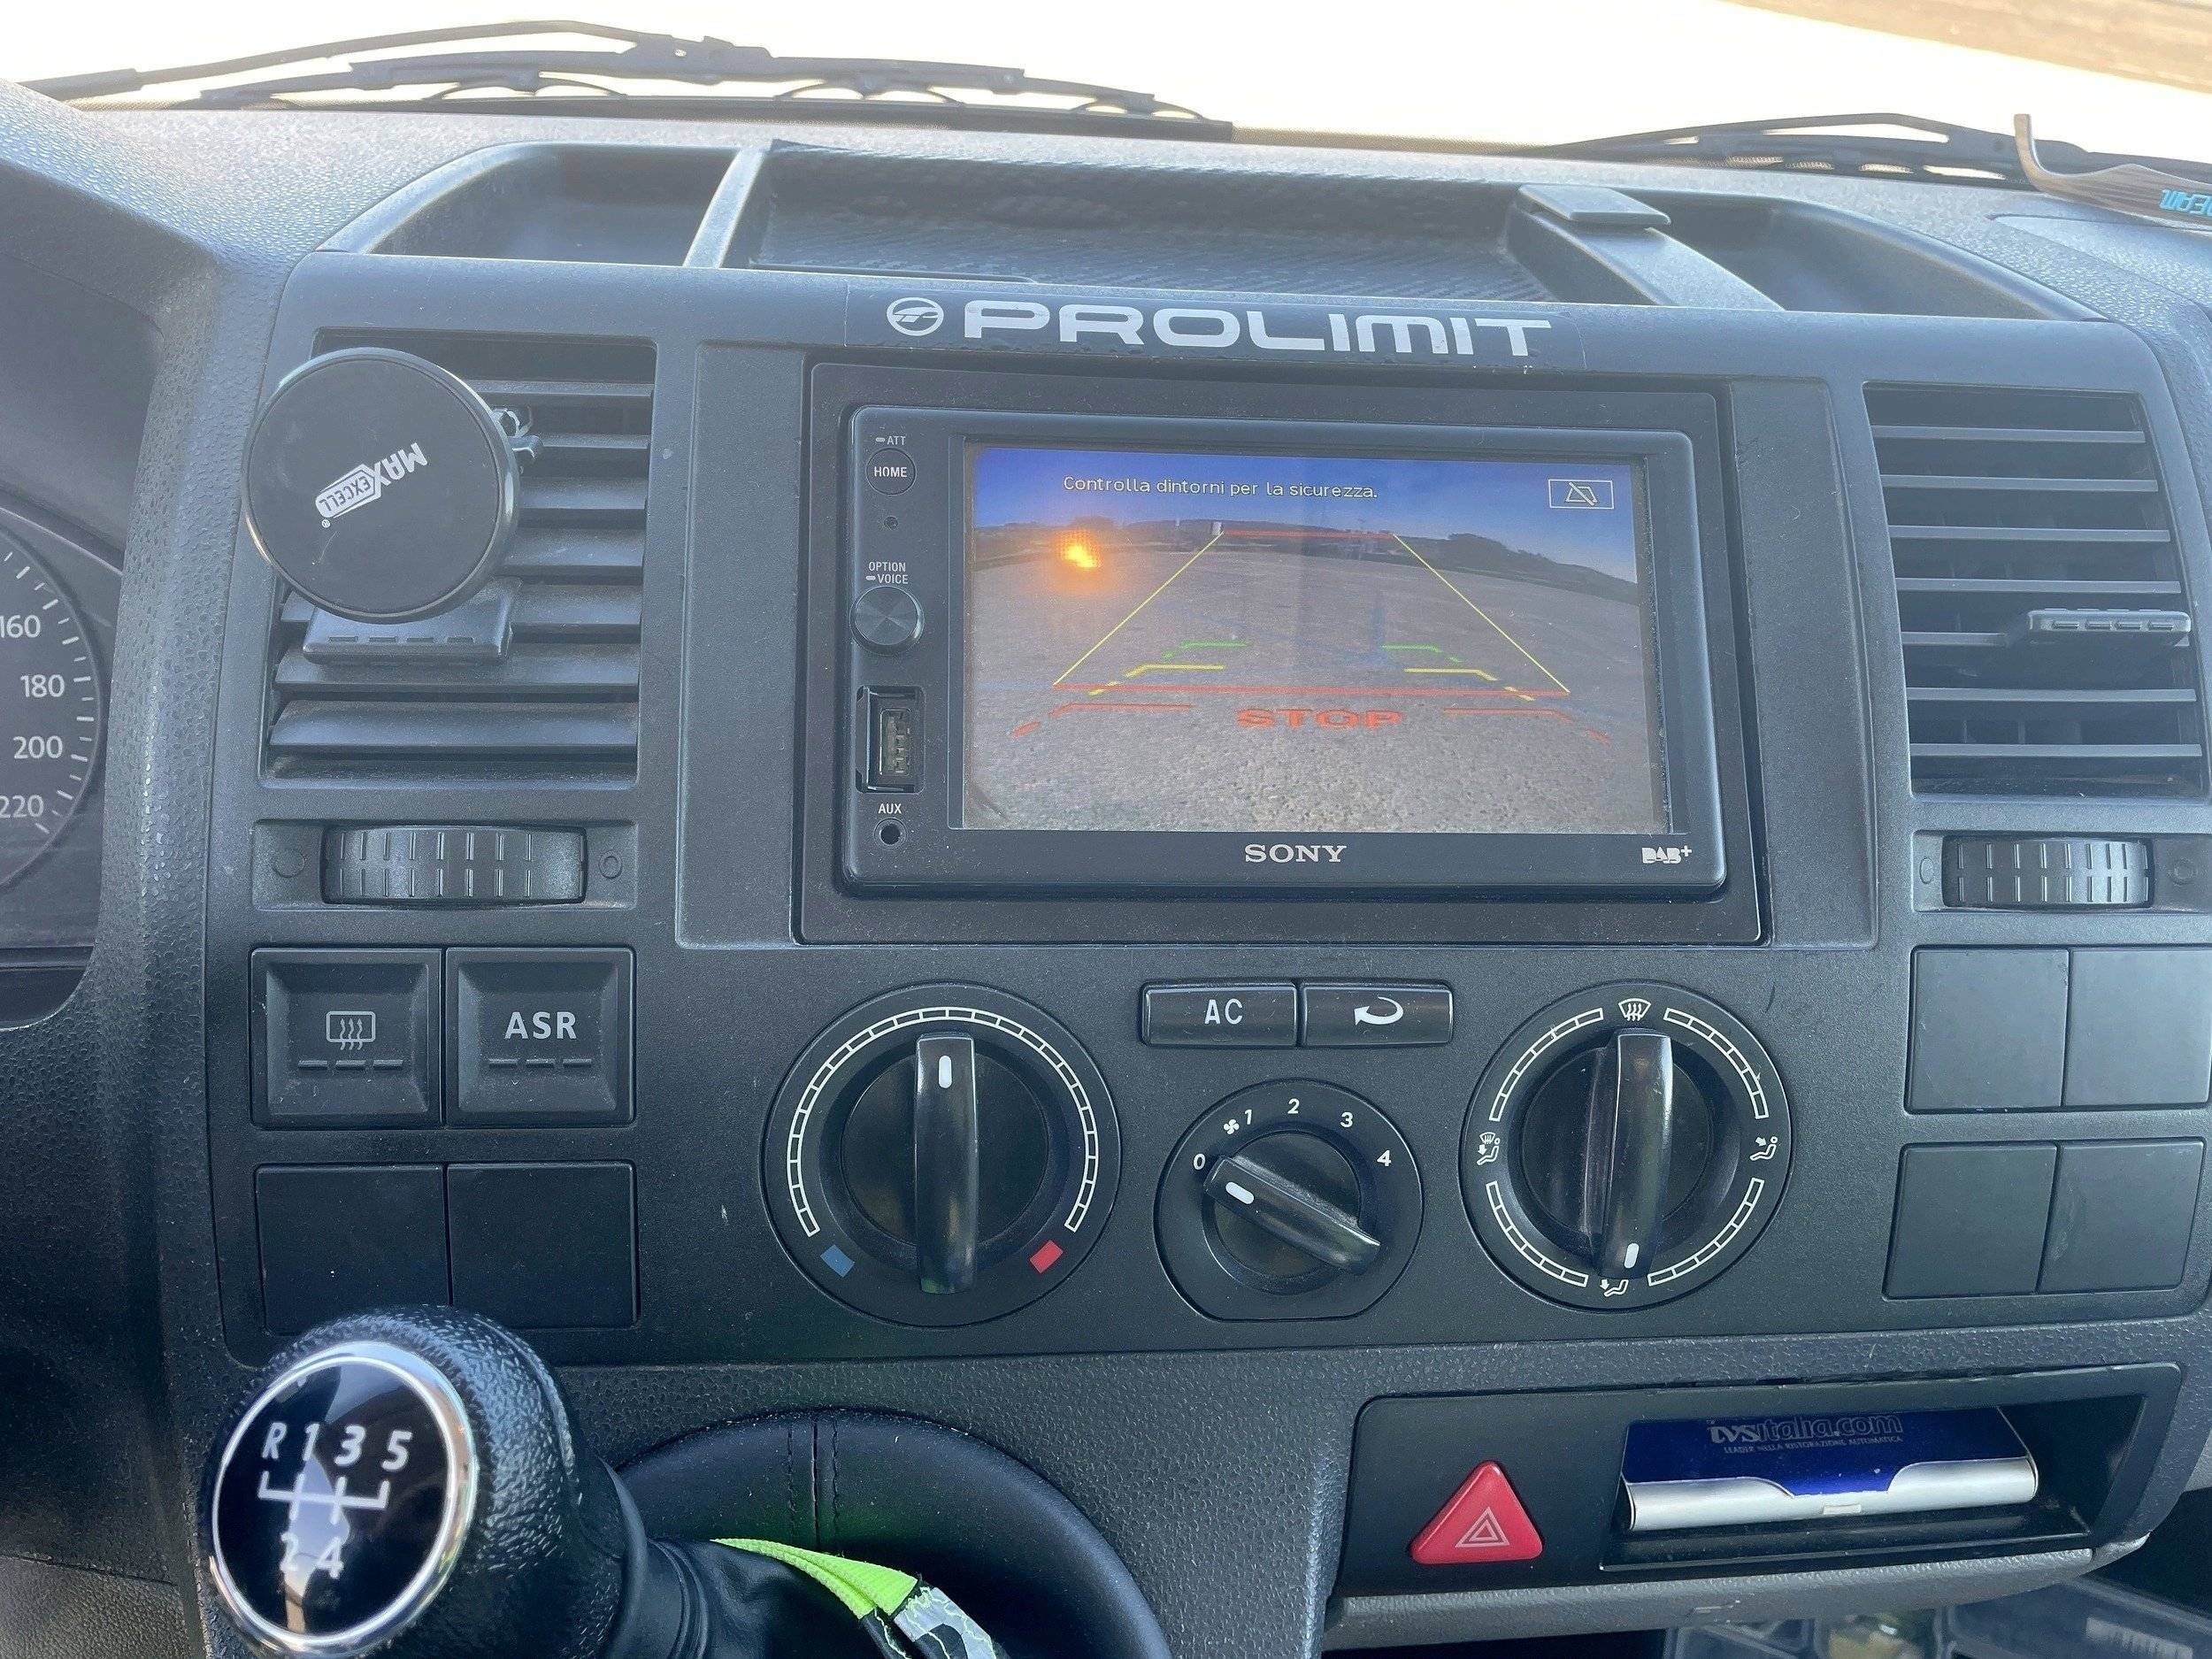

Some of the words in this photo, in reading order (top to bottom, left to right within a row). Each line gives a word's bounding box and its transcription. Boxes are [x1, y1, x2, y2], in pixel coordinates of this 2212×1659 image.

[964, 299, 1553, 357] PROLIMIT
[887, 435, 906, 446] ATT
[873, 465, 908, 478] HOME
[1064, 476, 1151, 492] Controlla
[1156, 479, 1225, 494] dintorni
[1230, 482, 1259, 497] per
[1266, 482, 1283, 495] la
[1289, 483, 1378, 498] sicurezza.
[868, 561, 907, 572] OPTION
[877, 573, 909, 585] VOICE
[20, 674, 65, 697] 180
[1237, 708, 1404, 729] STOP
[13, 735, 64, 759] 200
[0, 795, 44, 818] 220
[878, 803, 902, 814] AUX
[1244, 844, 1348, 864] SONY
[1641, 845, 1693, 864] DAB+
[1203, 998, 1243, 1025] AC
[504, 1011, 577, 1040] ASR
[1193, 1153, 1206, 1171] 0
[1244, 1109, 1253, 1125] 1
[1287, 1098, 1301, 1115] 2
[1340, 1111, 1354, 1128] 3
[1376, 1149, 1393, 1167] 4
[261, 1422, 288, 1460] R
[302, 1423, 320, 1462] 1
[333, 1425, 367, 1467] 3
[381, 1429, 413, 1471] 5
[280, 1531, 299, 1571] 2
[315, 1536, 345, 1579] 4
